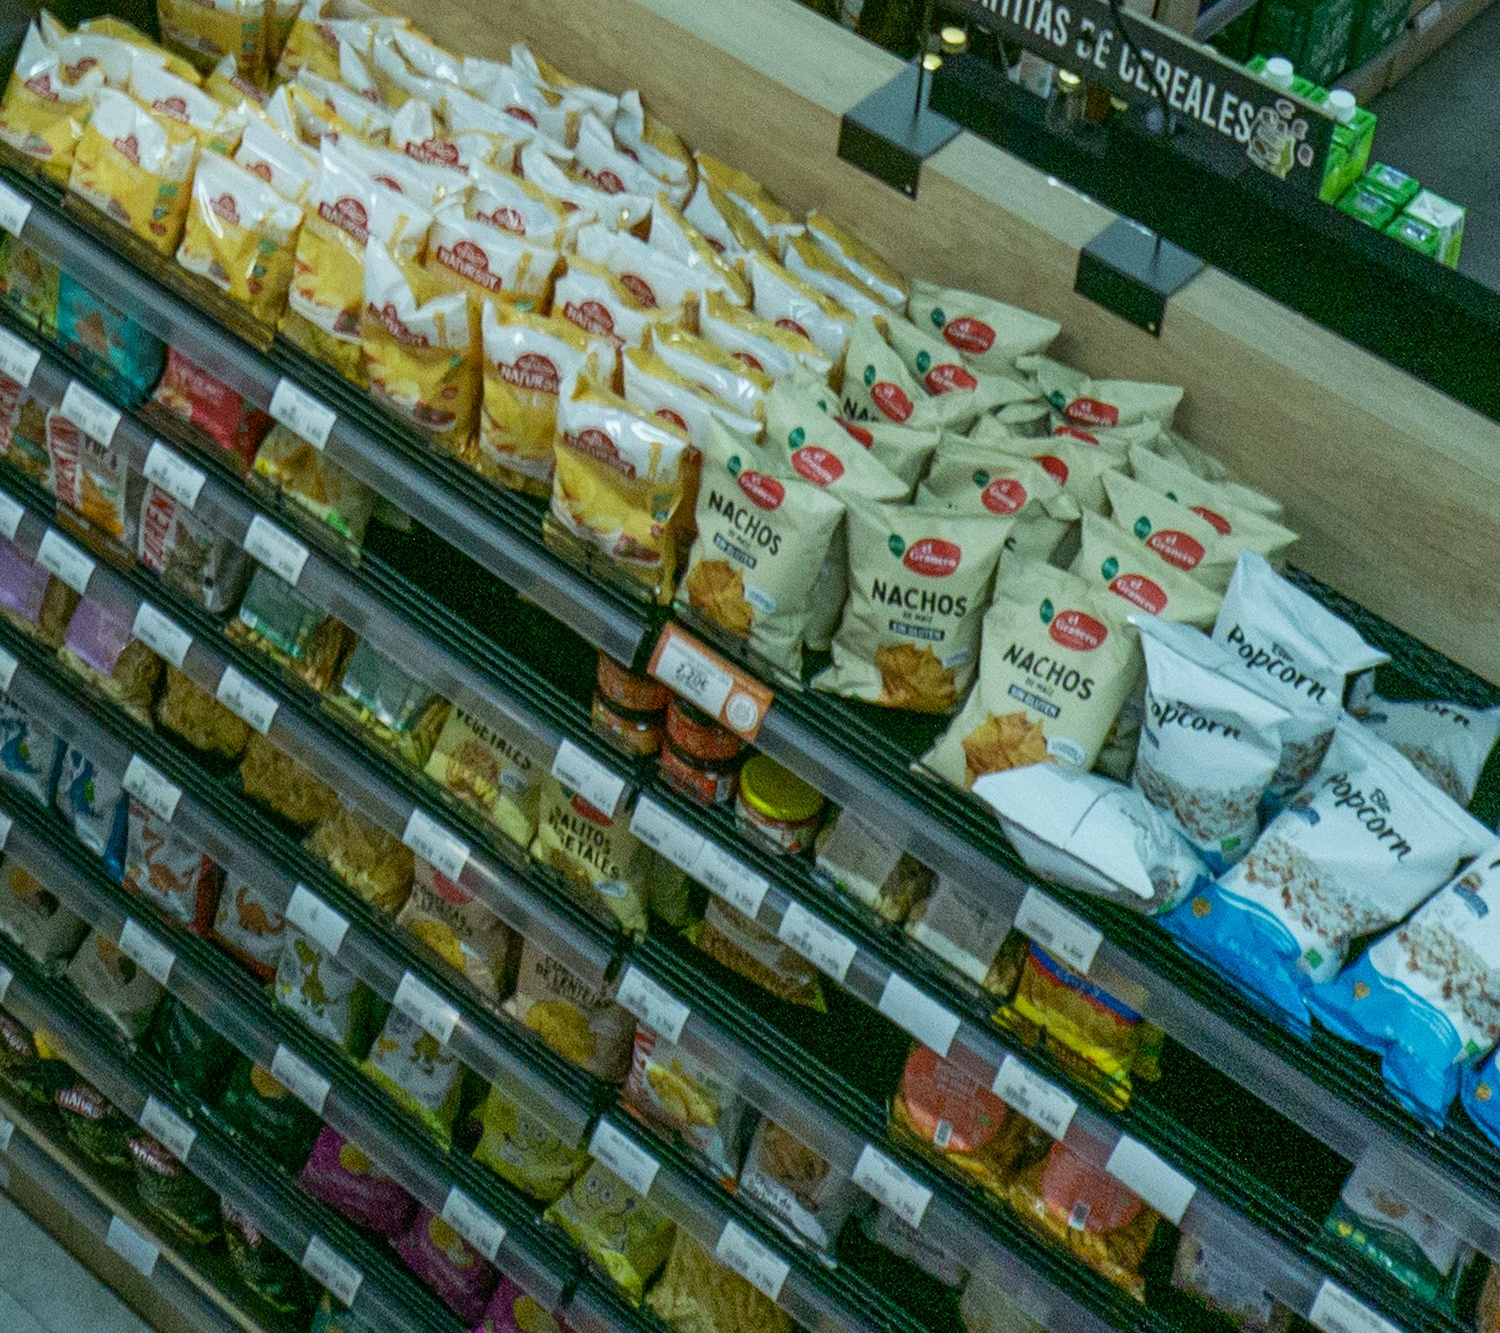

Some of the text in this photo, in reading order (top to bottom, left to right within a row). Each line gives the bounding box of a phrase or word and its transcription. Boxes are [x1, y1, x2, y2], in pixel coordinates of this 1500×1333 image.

[1076, 18, 1114, 69] DE
[1118, 42, 1254, 143] CEREALES
[707, 488, 783, 558] NACHOS
[871, 578, 966, 617] NACHOS
[1002, 643, 1094, 705] NACHOS
[1227, 626, 1326, 704] Popcorn
[1322, 772, 1412, 863] Popcorn
